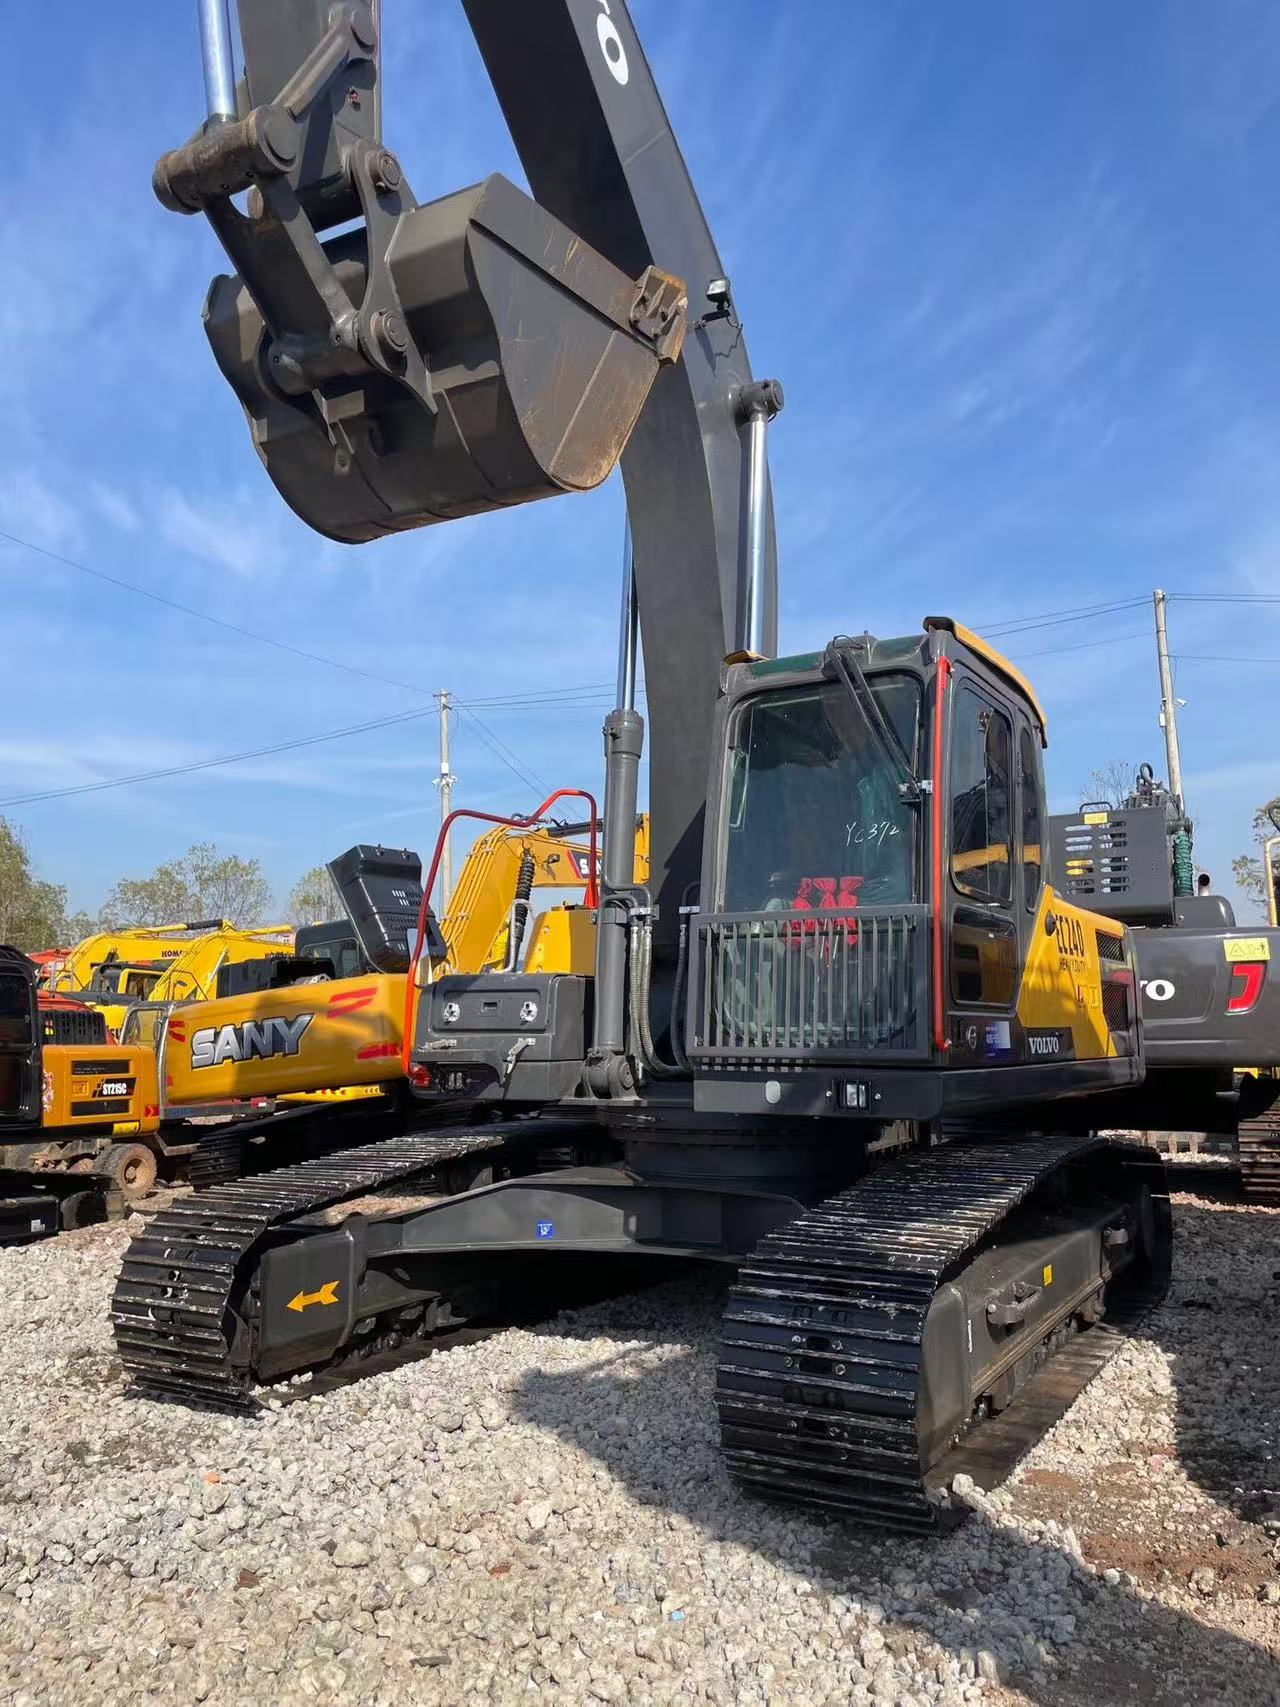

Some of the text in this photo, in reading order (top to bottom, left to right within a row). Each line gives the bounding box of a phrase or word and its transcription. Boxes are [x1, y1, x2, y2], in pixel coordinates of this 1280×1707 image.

[190, 1012, 316, 1069] SANY
[1028, 1036, 1060, 1055] VOLVO
[102, 1083, 128, 1096] SY215C
